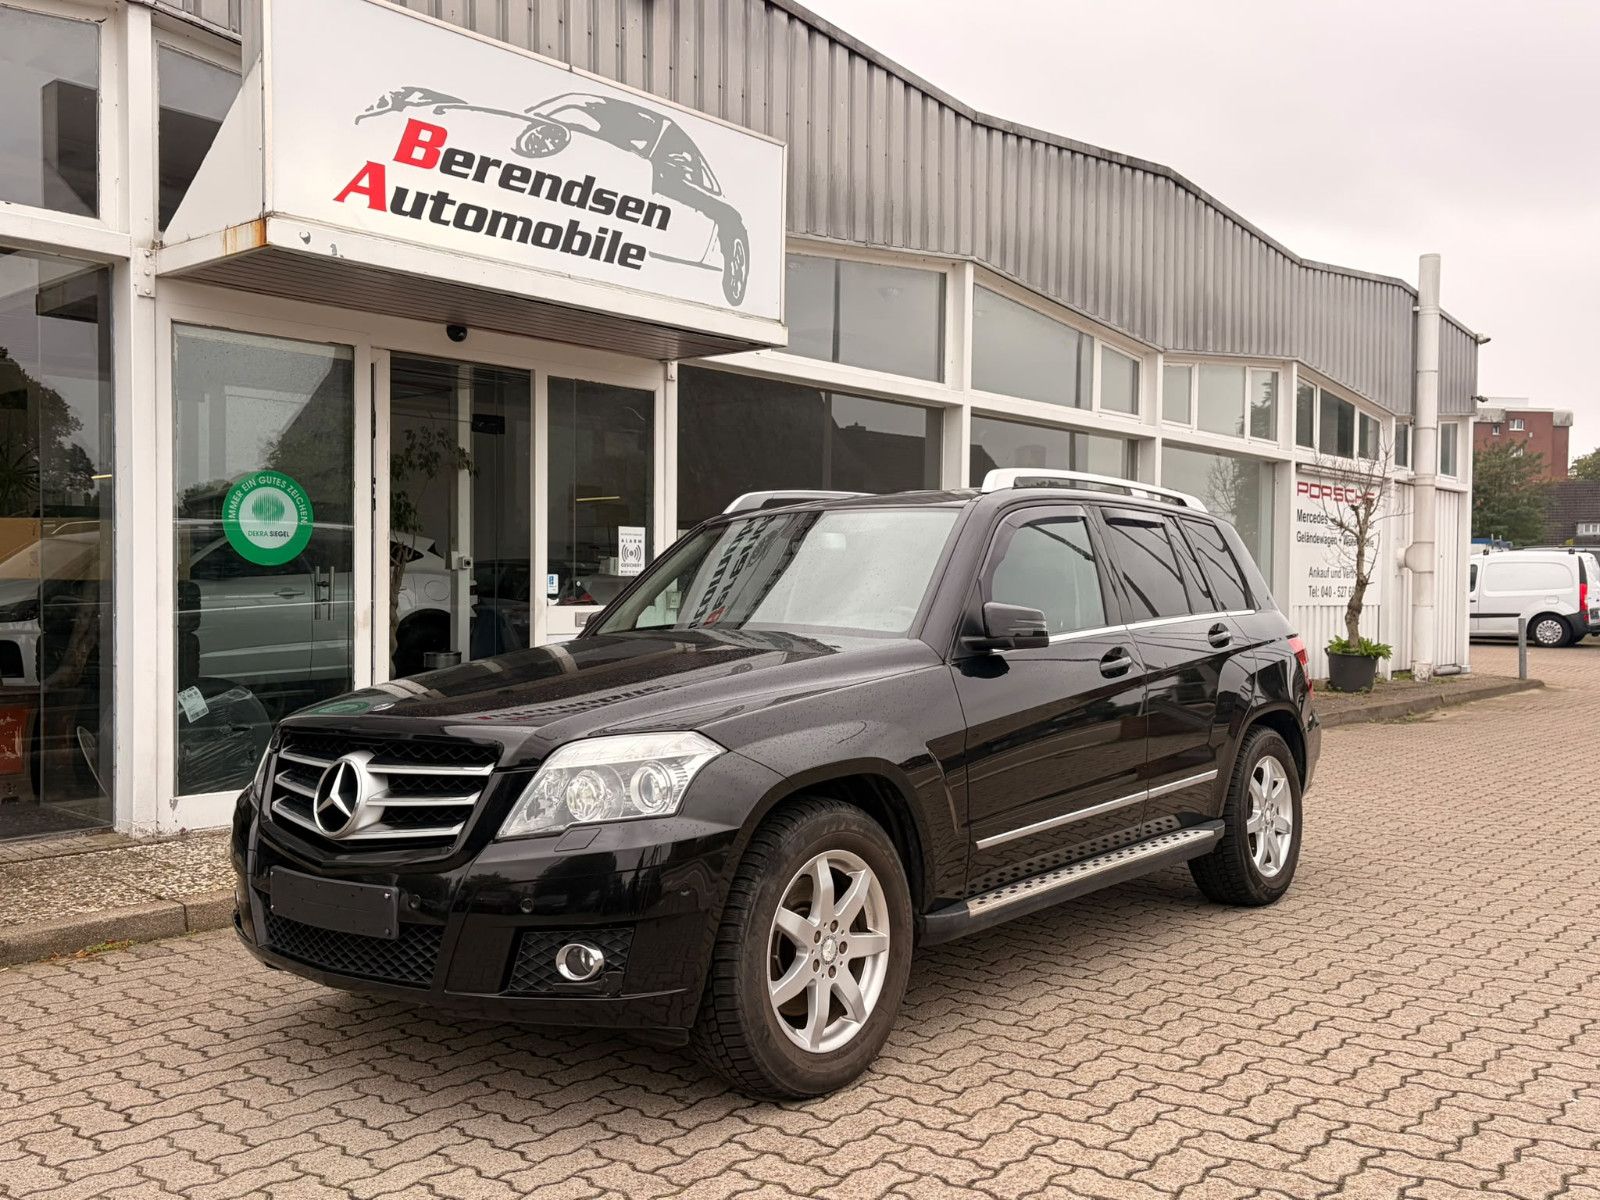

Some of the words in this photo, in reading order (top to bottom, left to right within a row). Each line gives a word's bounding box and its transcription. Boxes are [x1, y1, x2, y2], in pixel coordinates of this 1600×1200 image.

[393, 117, 672, 231] Berendsen
[332, 160, 647, 270] Automobile
[228, 490, 244, 521] IMMER
[241, 478, 257, 491] EIN
[258, 476, 287, 488] GUTES
[286, 485, 309, 525] ZEICHEN
[1296, 509, 1329, 525] Mercedes
[269, 530, 289, 538] SIEGEL
[1296, 530, 1338, 547] Geländewagen
[1308, 566, 1330, 579] Ankauf
[1330, 567, 1342, 579] und
[1308, 585, 1320, 598] Tel:
[1320, 586, 1333, 598] 040
[1337, 586, 1348, 598] 527
